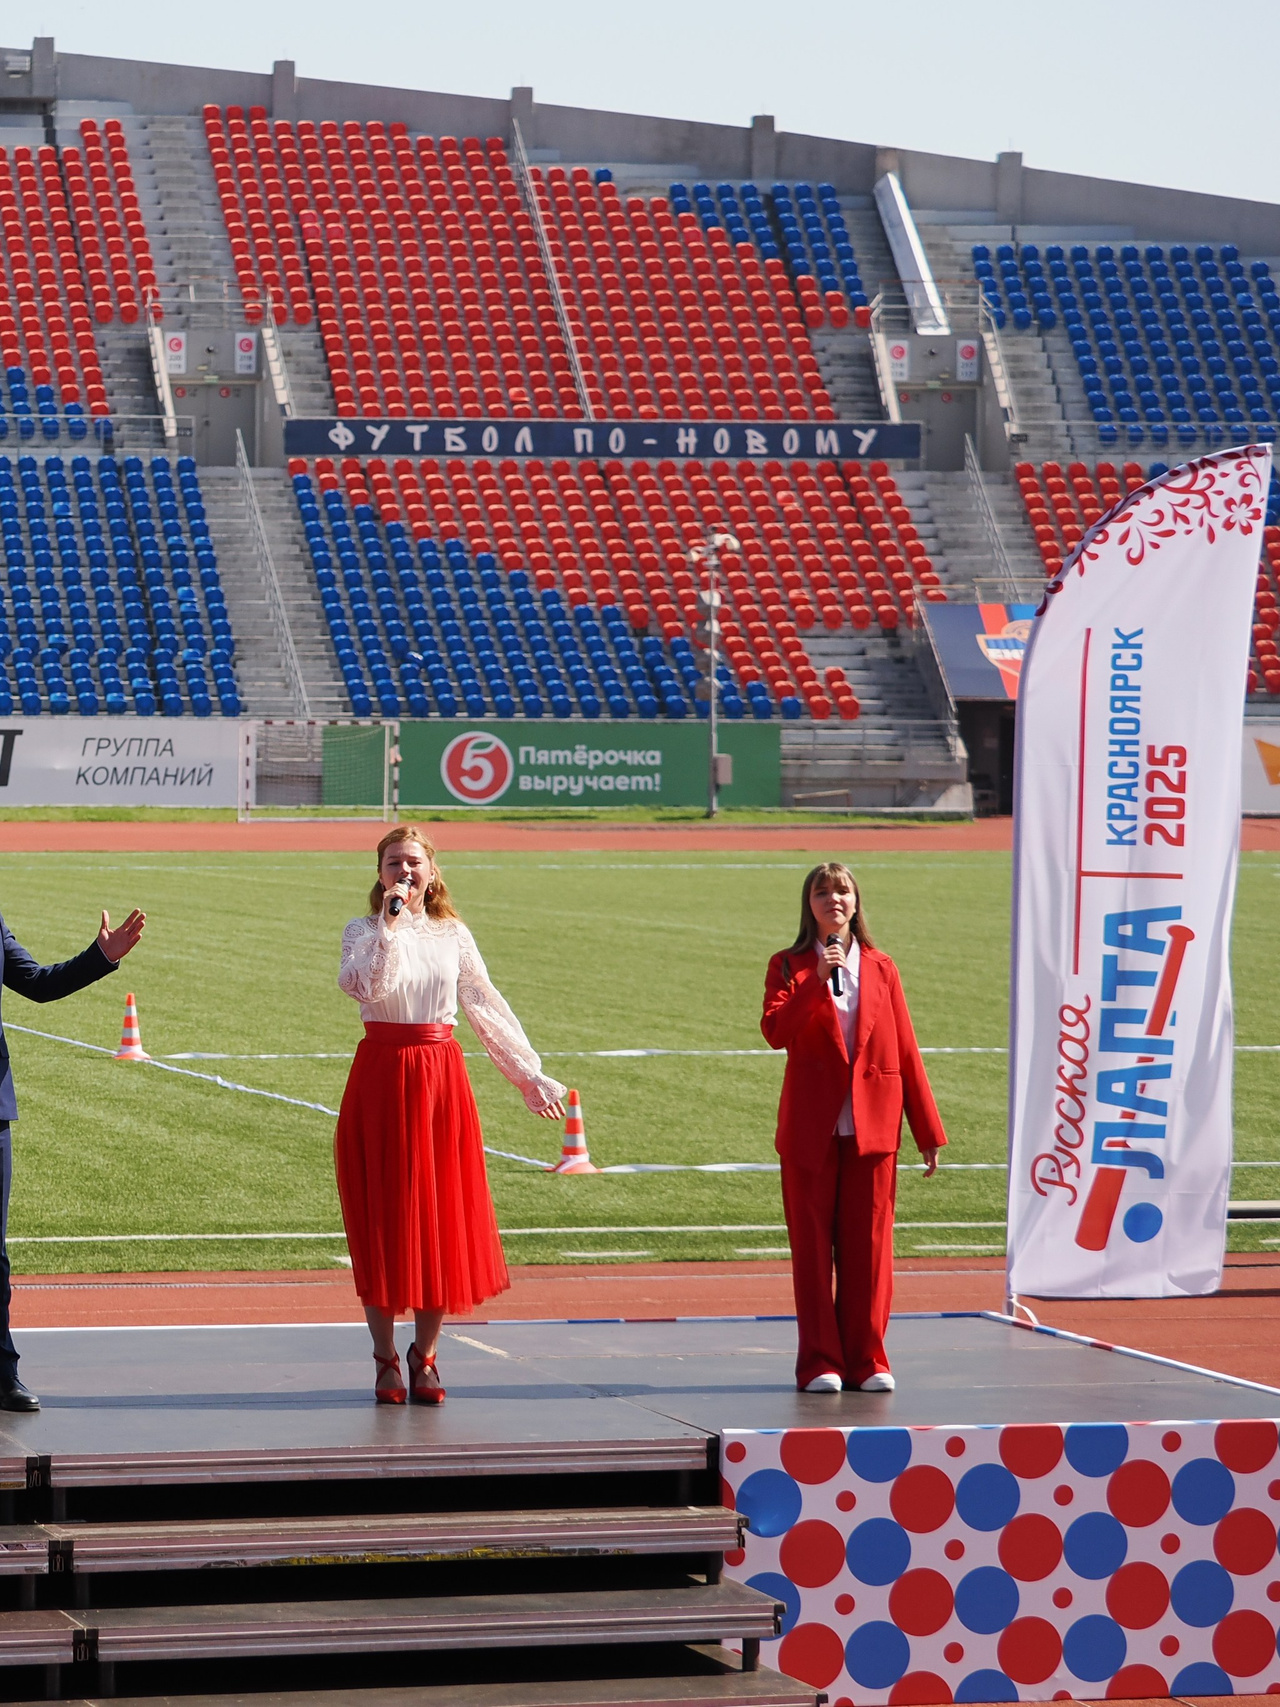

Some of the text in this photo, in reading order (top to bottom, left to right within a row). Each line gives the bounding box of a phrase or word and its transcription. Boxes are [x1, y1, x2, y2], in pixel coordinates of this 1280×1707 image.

[328, 421, 878, 455] ФУТБОЛ ПО-НОВОМУ
[82, 737, 175, 757] ГРУППА
[1106, 627, 1144, 846] КРАСНОЯРСК
[518, 744, 662, 770] Пятёрочка
[75, 762, 214, 787] КОМПАНИЙ
[518, 773, 662, 796] выручает!
[1144, 744, 1187, 847] 2025
[1091, 905, 1182, 1179] ЛАПТА
[1030, 993, 1090, 1206] Русская
